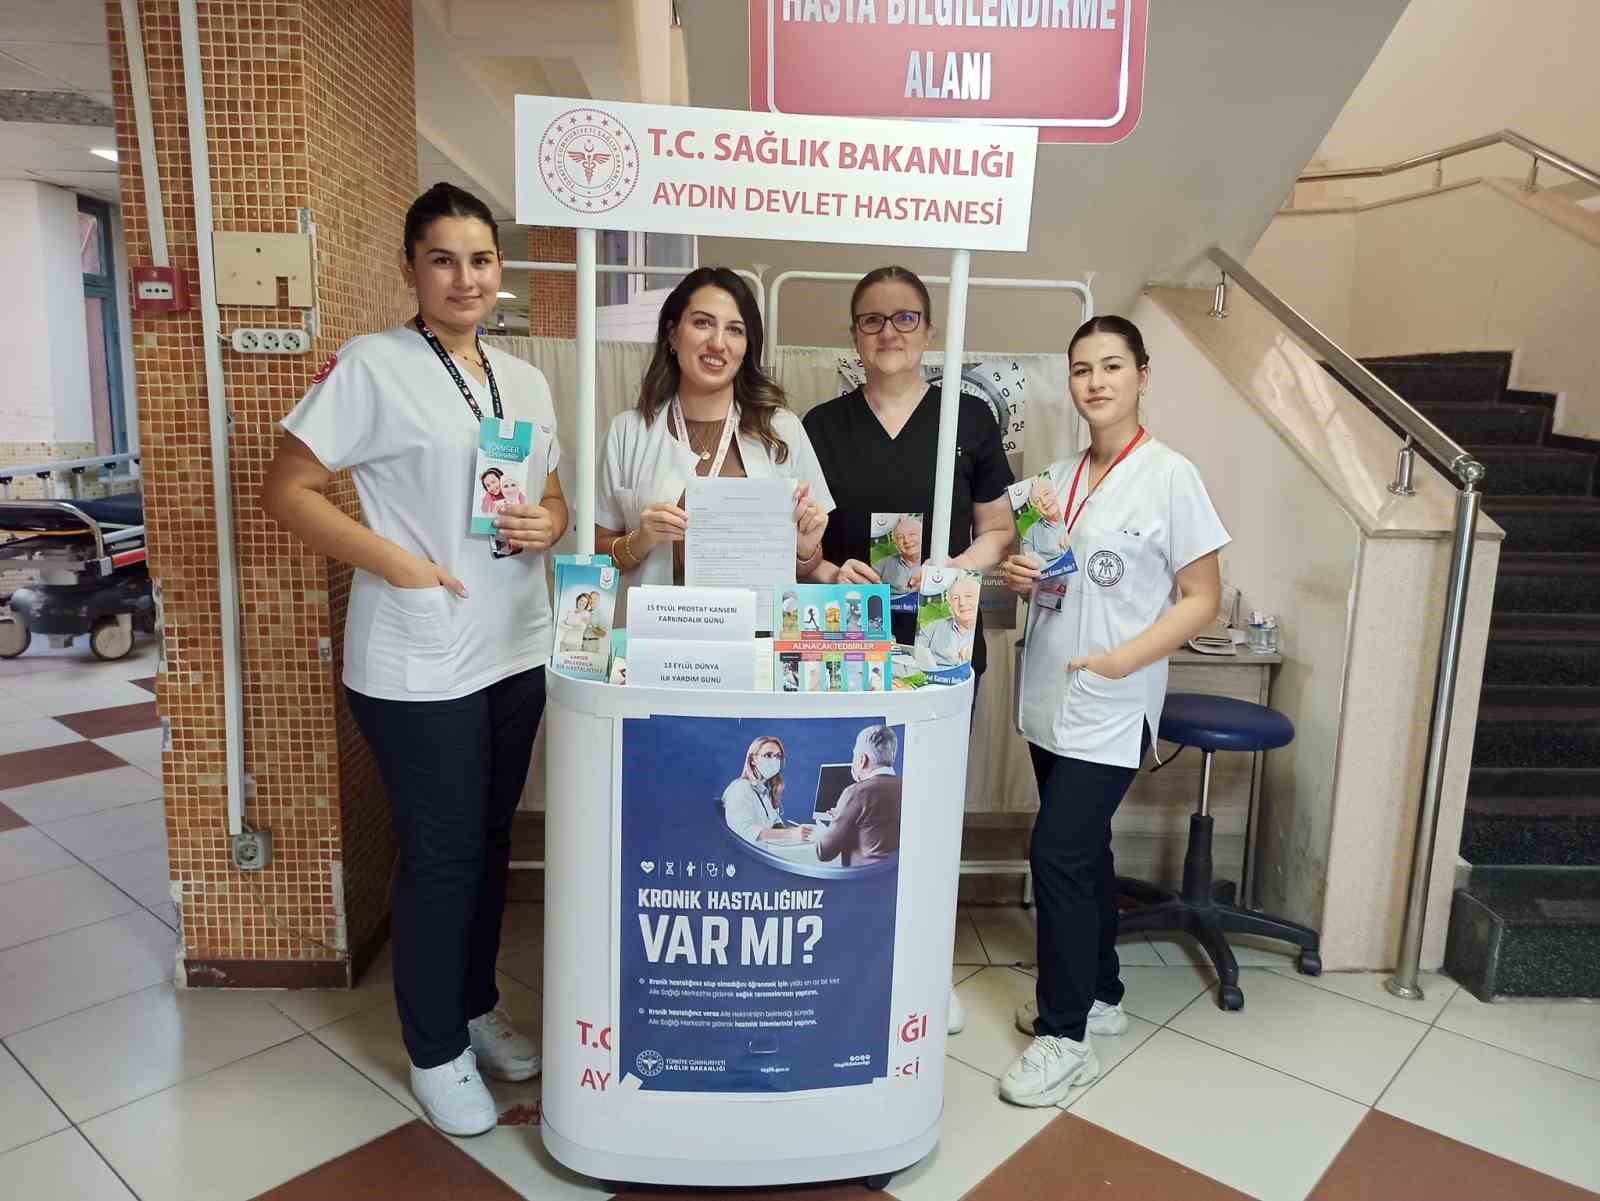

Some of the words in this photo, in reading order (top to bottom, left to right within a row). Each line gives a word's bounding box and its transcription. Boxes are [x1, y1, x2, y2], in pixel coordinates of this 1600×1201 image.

[904, 50, 992, 100] ALANI
[648, 128, 705, 160] T.C.
[714, 129, 831, 168] SAĞLIK
[838, 141, 1014, 178] BAKANLIĞI
[652, 182, 736, 210] AYDIN
[745, 188, 848, 217] DEVLET
[854, 194, 1003, 225] HASTANESİ
[1011, 361, 1019, 371] 4
[656, 603, 676, 613] EYLÜL
[678, 604, 708, 613] PROSTAT
[792, 641, 832, 651] ALINACAK
[638, 888, 702, 910] KRONİK
[707, 889, 824, 911] HASTALIĞINIZ
[638, 913, 730, 965] VAR
[741, 915, 823, 965] MI?
[898, 1012, 927, 1043] ĞI
